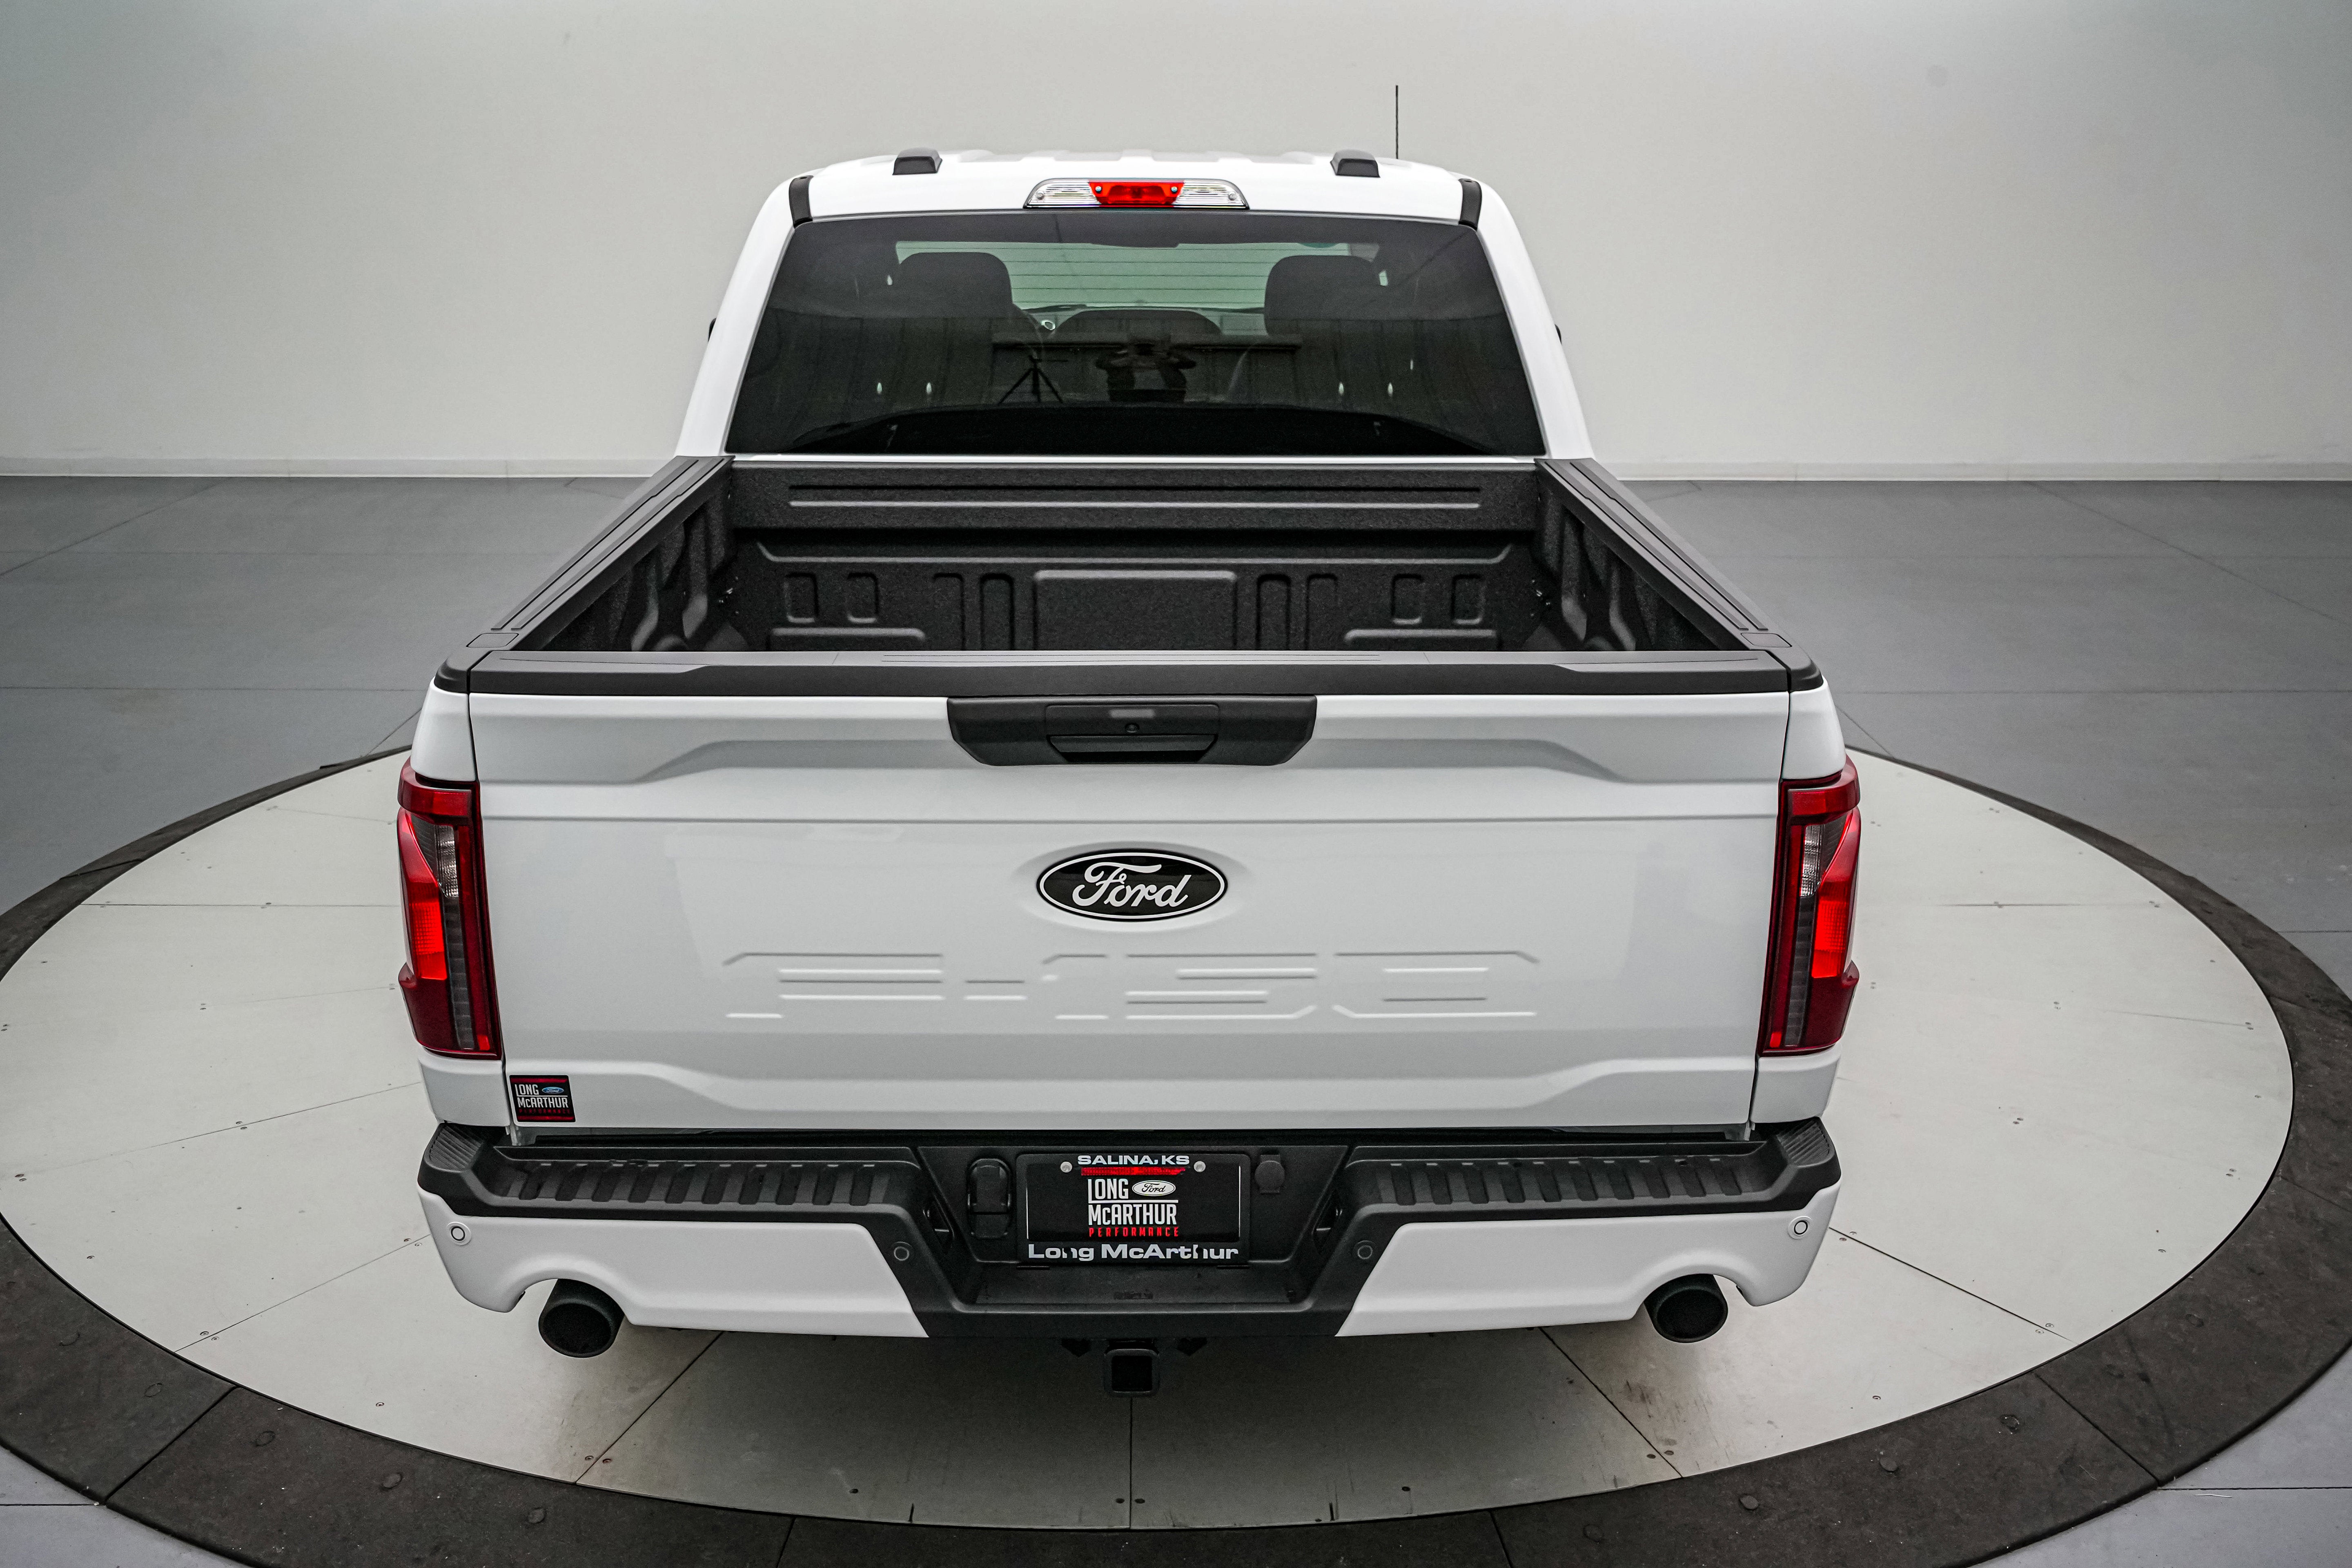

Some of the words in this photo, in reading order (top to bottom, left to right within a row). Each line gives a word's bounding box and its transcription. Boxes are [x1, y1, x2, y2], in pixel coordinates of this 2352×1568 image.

[1072, 862, 1192, 907] Ford
[514, 1084, 539, 1097] LONG
[517, 1097, 569, 1108] McARTHUR
[1077, 1155, 1158, 1165] SALINA,
[1162, 1155, 1190, 1165] KS
[1087, 1178, 1129, 1203] LONG
[1141, 1183, 1167, 1193] Ford
[1088, 1203, 1177, 1225] McARTHUR
[1089, 1227, 1179, 1237] PERFORMANCE
[1028, 1243, 1094, 1262] Long
[1101, 1243, 1239, 1260] McArthur
